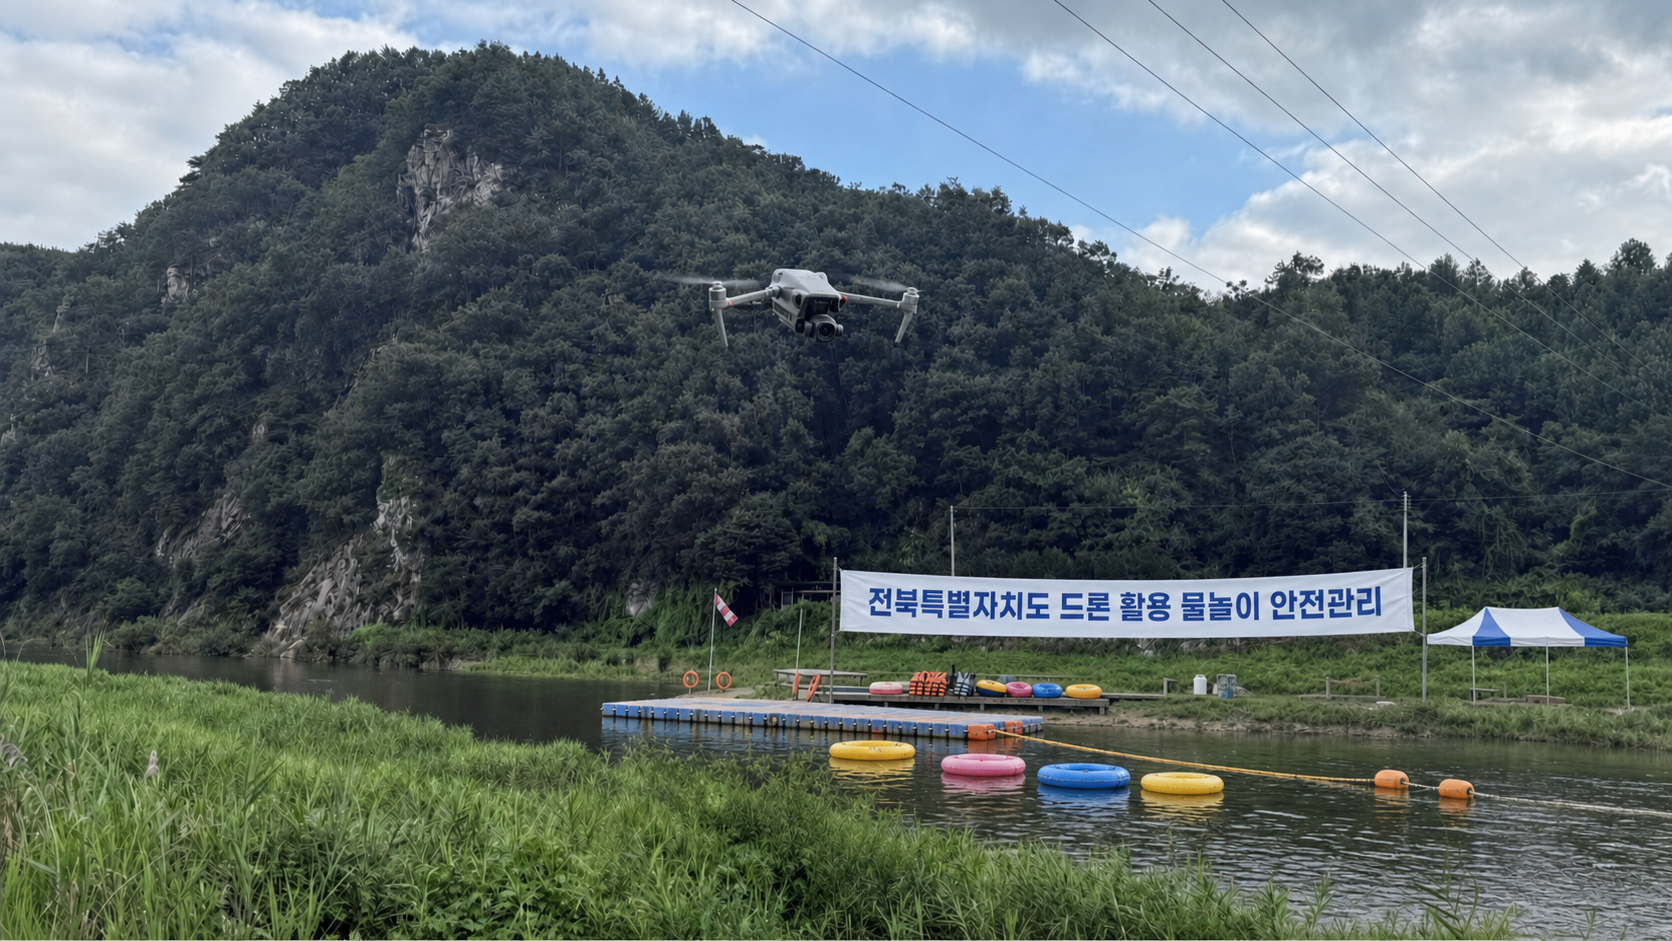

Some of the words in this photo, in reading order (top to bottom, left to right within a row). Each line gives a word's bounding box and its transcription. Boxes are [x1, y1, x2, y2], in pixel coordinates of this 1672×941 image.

[868, 587, 1051, 621] 전북특별자치도
[1059, 592, 1111, 622] 드론
[1119, 591, 1172, 622] 활용
[1180, 591, 1260, 622] 물놀이
[1270, 585, 1382, 621] 안전관리
